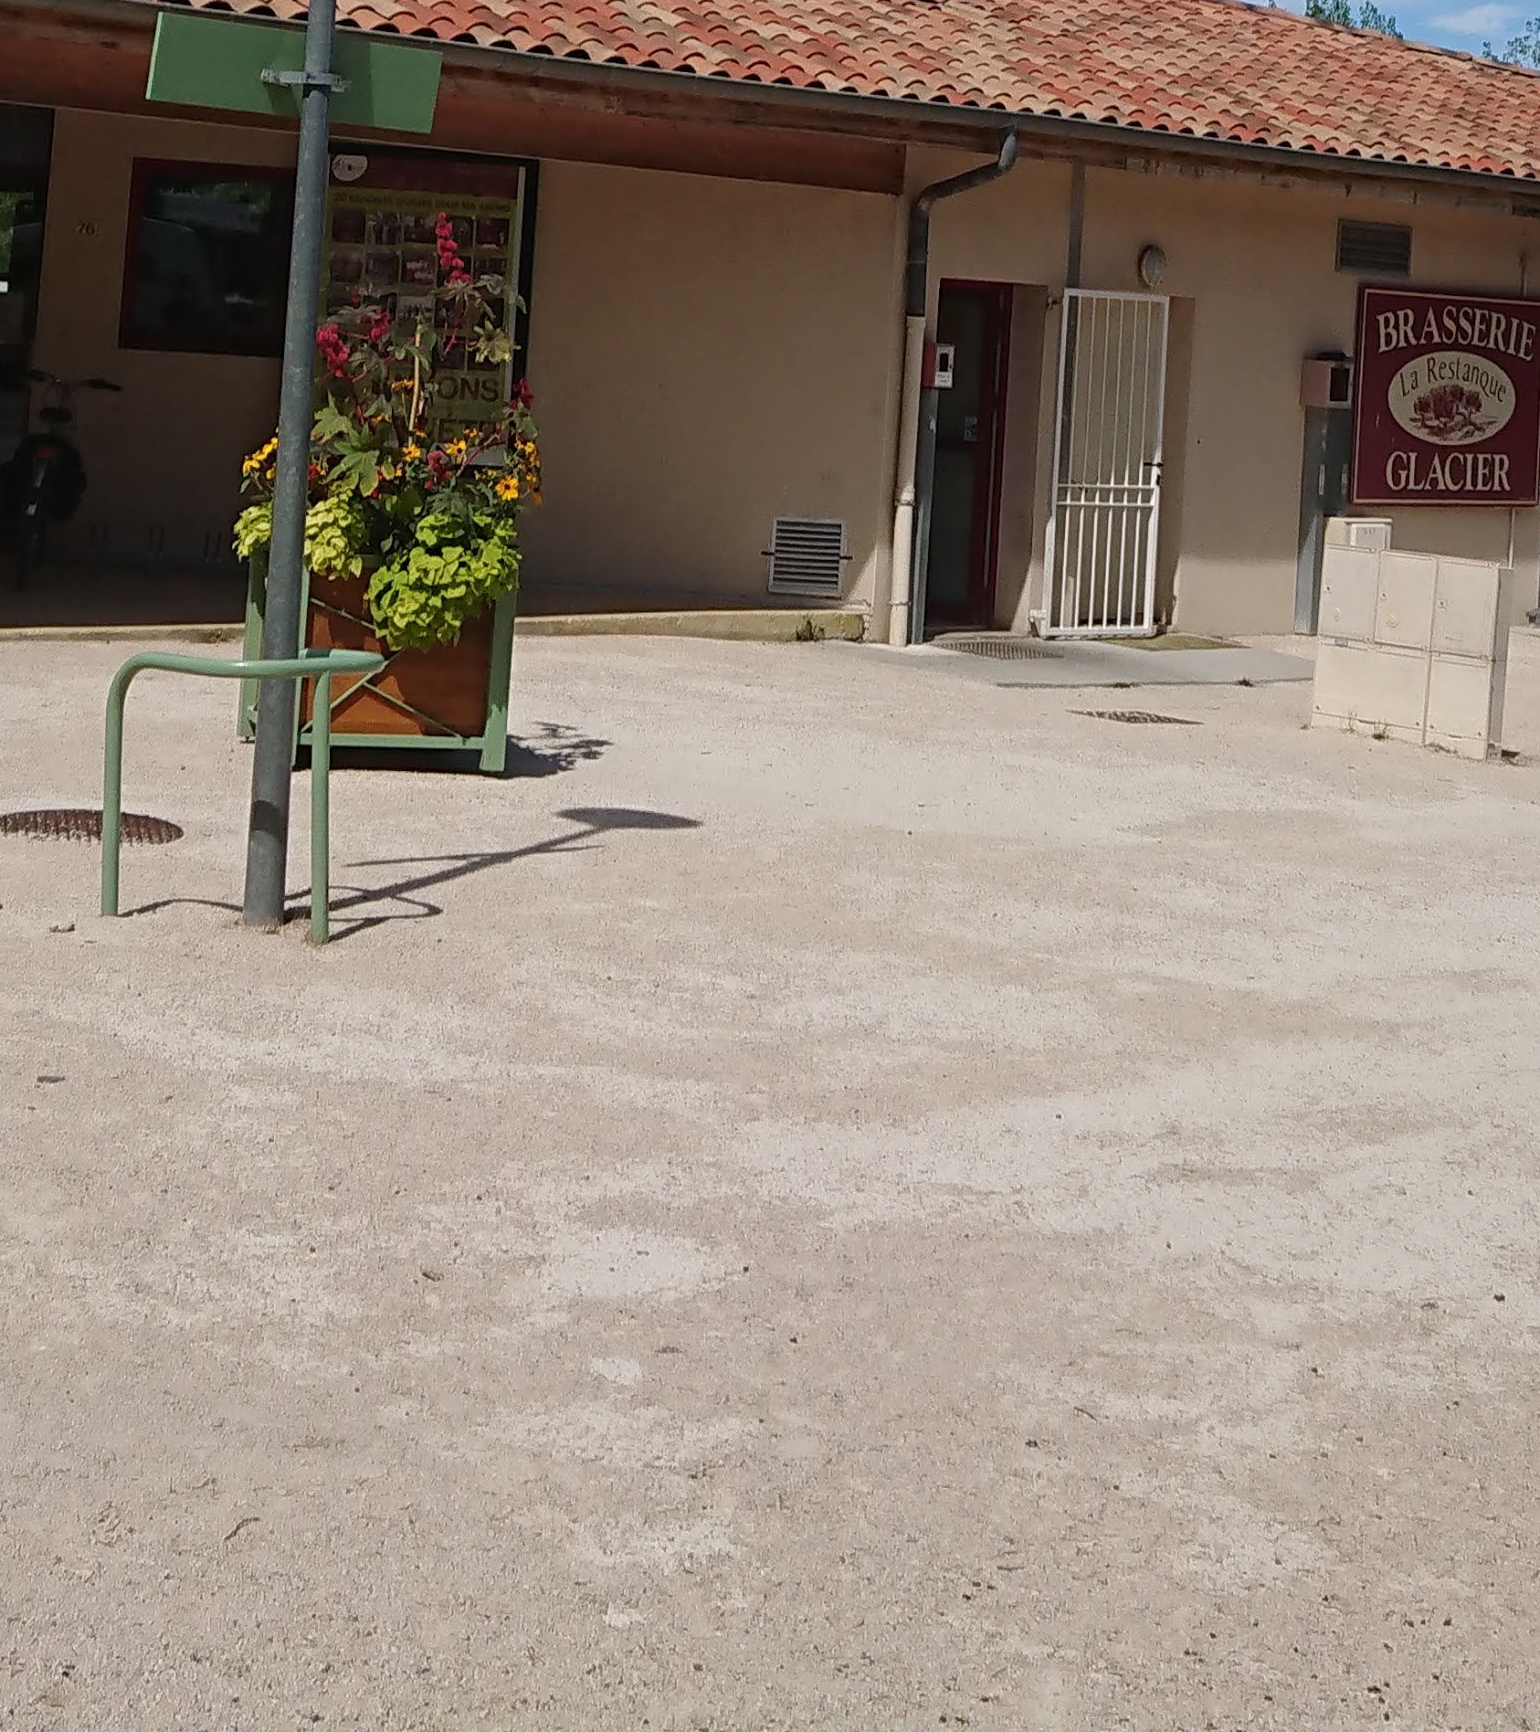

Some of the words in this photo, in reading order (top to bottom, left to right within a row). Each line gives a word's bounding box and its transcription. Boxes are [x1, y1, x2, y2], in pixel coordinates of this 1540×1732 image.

[1376, 306, 1536, 361] BRASSERIE
[1400, 372, 1418, 397] La
[1427, 357, 1507, 403] Restanque
[1386, 451, 1511, 492] GLACIER
